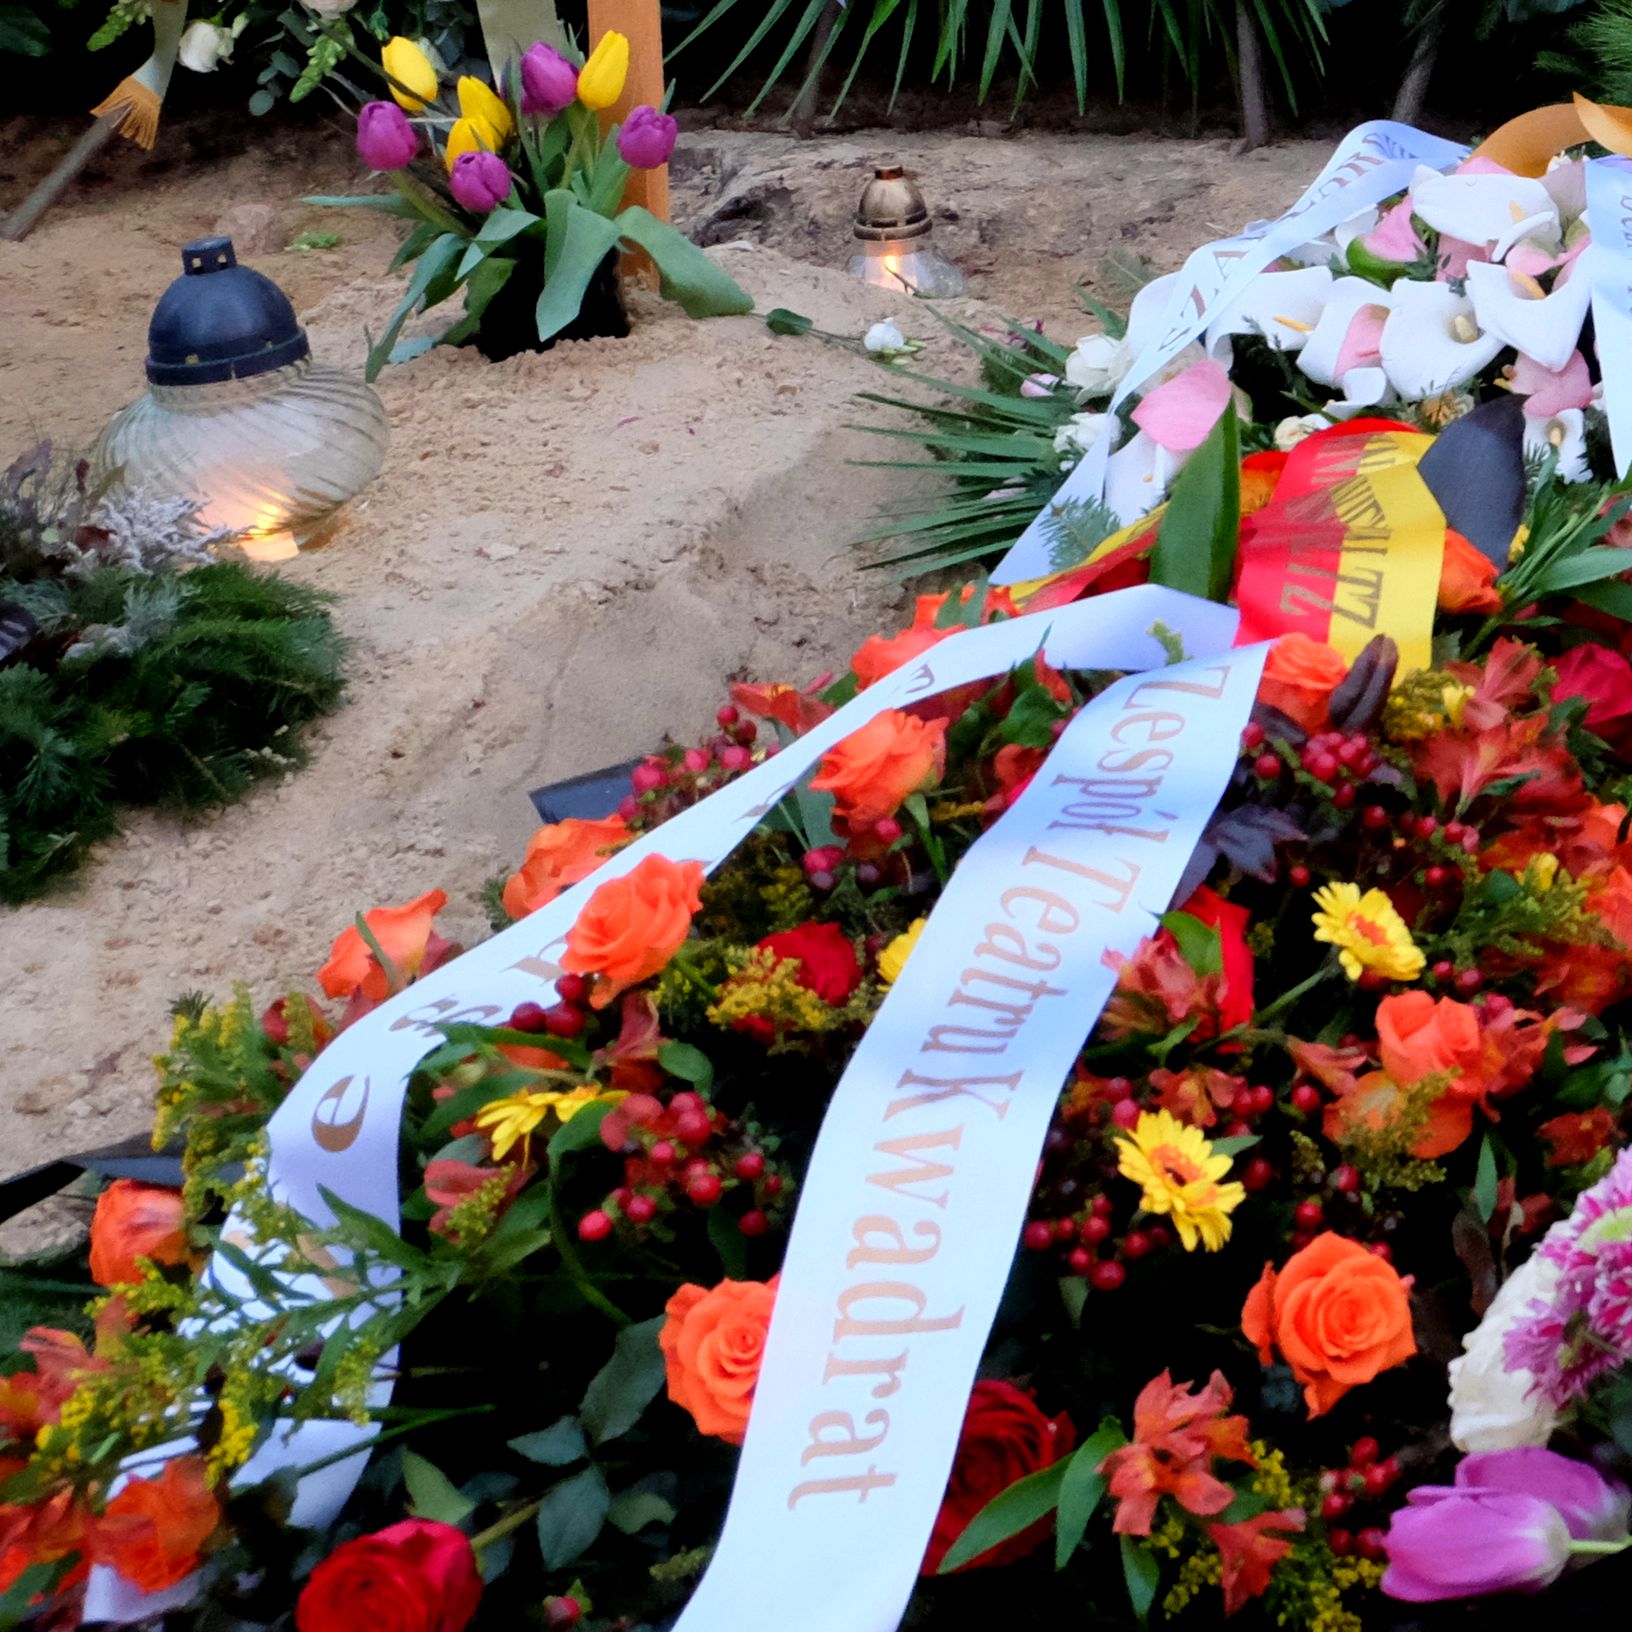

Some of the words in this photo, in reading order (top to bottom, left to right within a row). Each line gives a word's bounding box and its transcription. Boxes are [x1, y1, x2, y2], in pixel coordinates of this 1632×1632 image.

[1044, 660, 1236, 860] Zespół
[948, 845, 1144, 1077] Teatru
[786, 1048, 1024, 1517] Kwadrat
